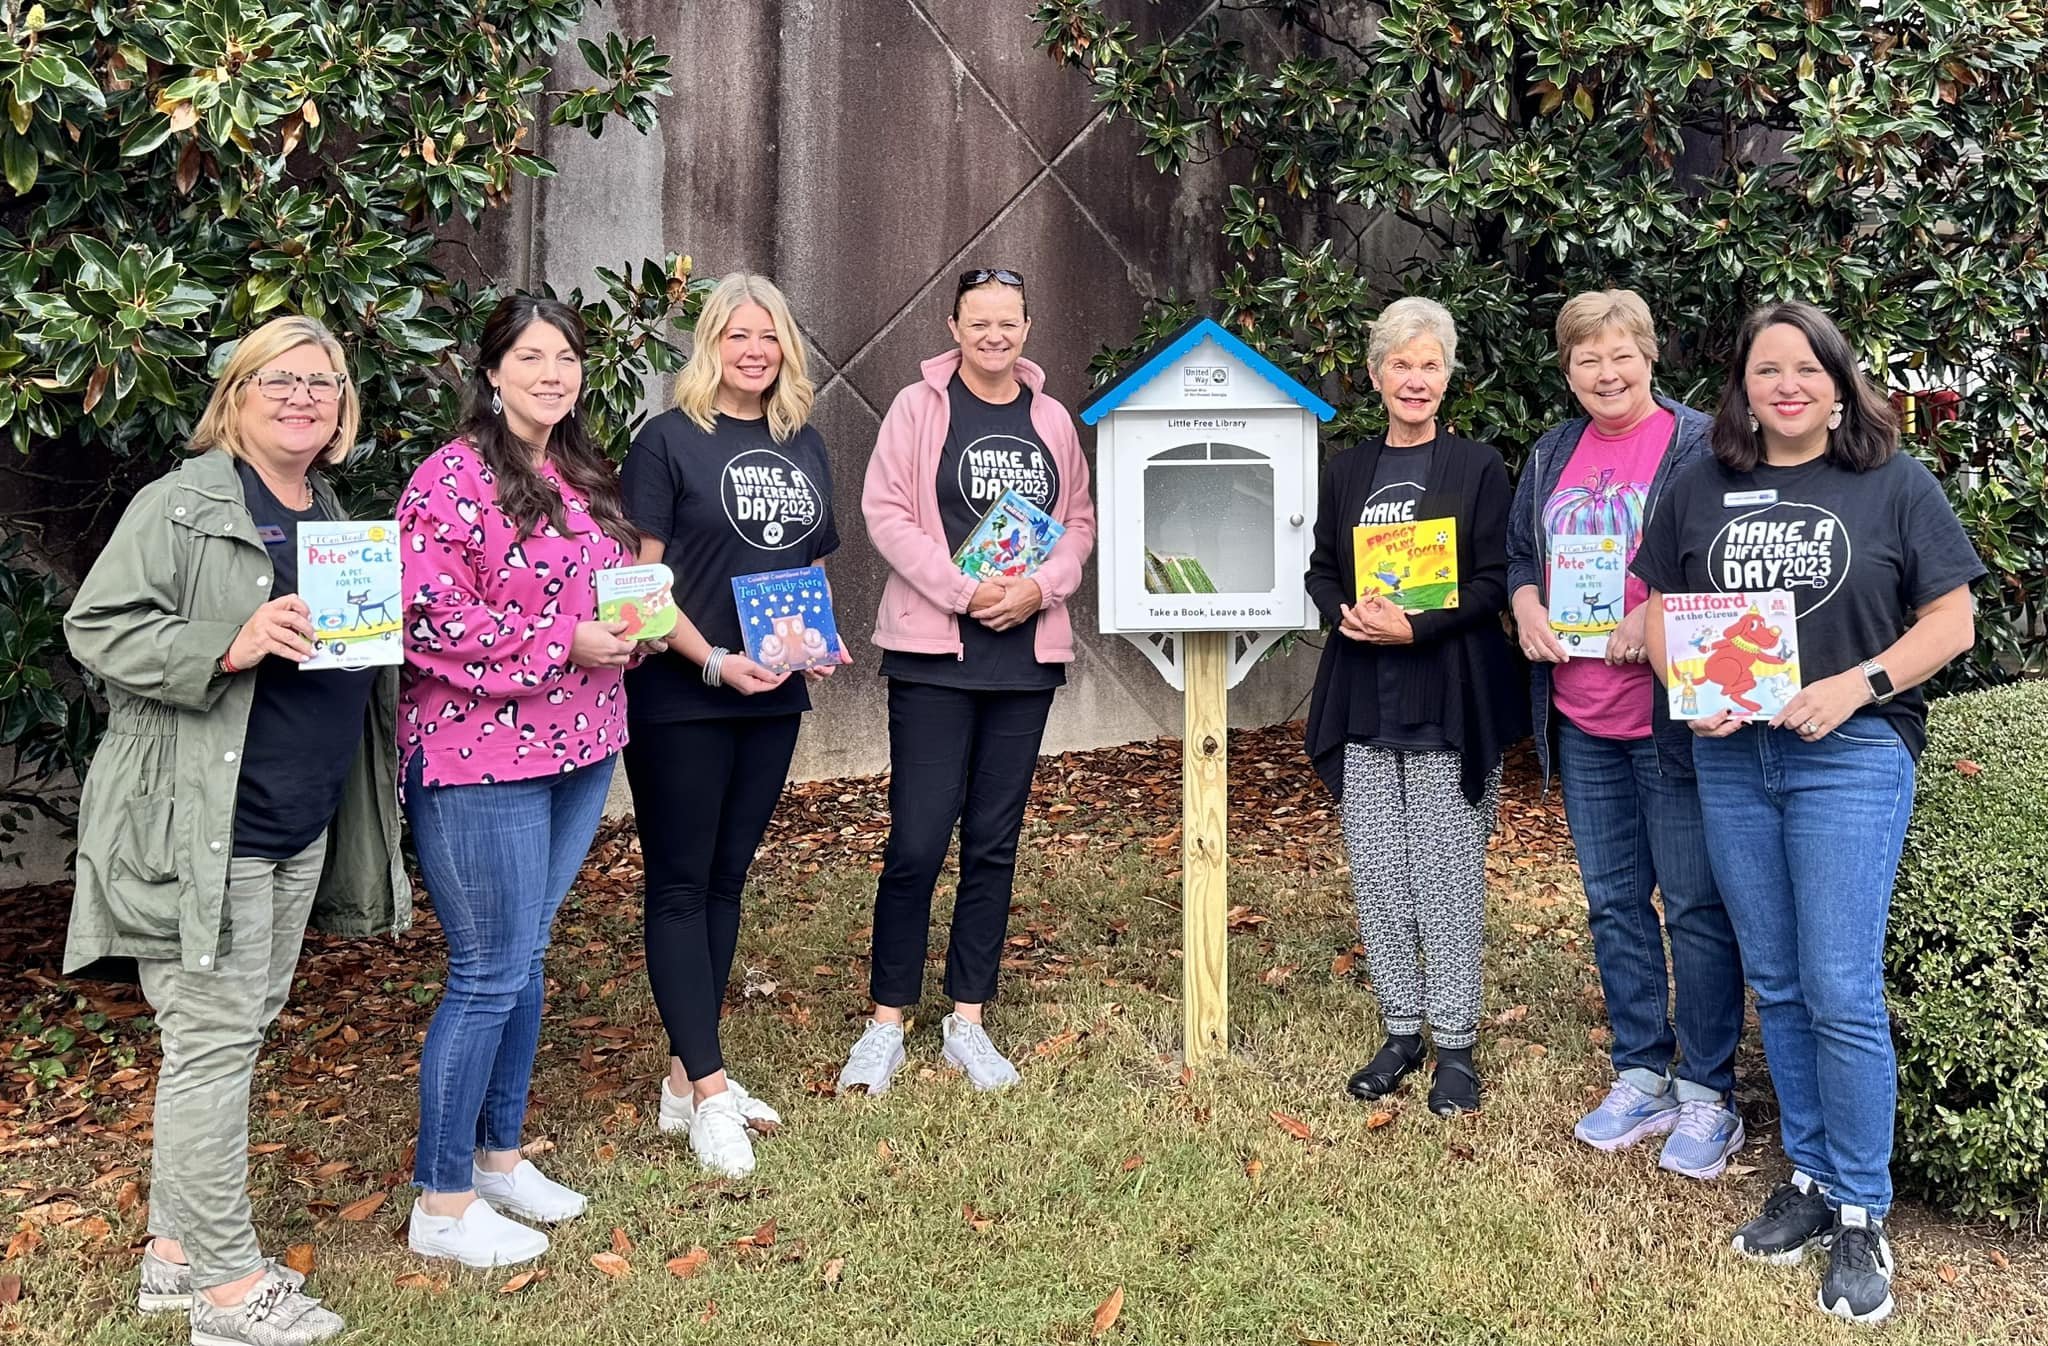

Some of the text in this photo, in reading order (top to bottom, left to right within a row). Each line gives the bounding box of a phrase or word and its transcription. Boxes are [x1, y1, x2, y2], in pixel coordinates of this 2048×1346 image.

[1185, 368, 1209, 376] United
[1194, 376, 1209, 385] Way
[1168, 419, 1191, 428] Little
[1194, 419, 1213, 428] Free
[1215, 419, 1247, 429] Library
[967, 449, 1045, 469] MAKE A
[728, 466, 807, 489] MAKE A
[970, 466, 1047, 481] DIFFERENCE
[734, 483, 812, 501] DIFFERENCE
[1015, 479, 1049, 496] 2023
[737, 496, 816, 521] DAY 2023
[1360, 499, 1416, 523] MAKE
[1727, 518, 1836, 544] MAKE A
[308, 547, 347, 565] Pete
[361, 547, 393, 563] Cat
[1723, 540, 1832, 560] DIFFERENCE
[1558, 554, 1585, 569] Pete
[1595, 556, 1619, 570] Cat
[335, 576, 372, 587] FOR PETE
[340, 568, 362, 577] A PET
[1723, 556, 1832, 589] DAY 2023
[740, 577, 823, 599] Ten Twinkly Stars
[1663, 593, 1748, 613] Clifford
[1148, 607, 1272, 618] Take a Book, Leave a Book
[1675, 610, 1739, 621] at the Circus
